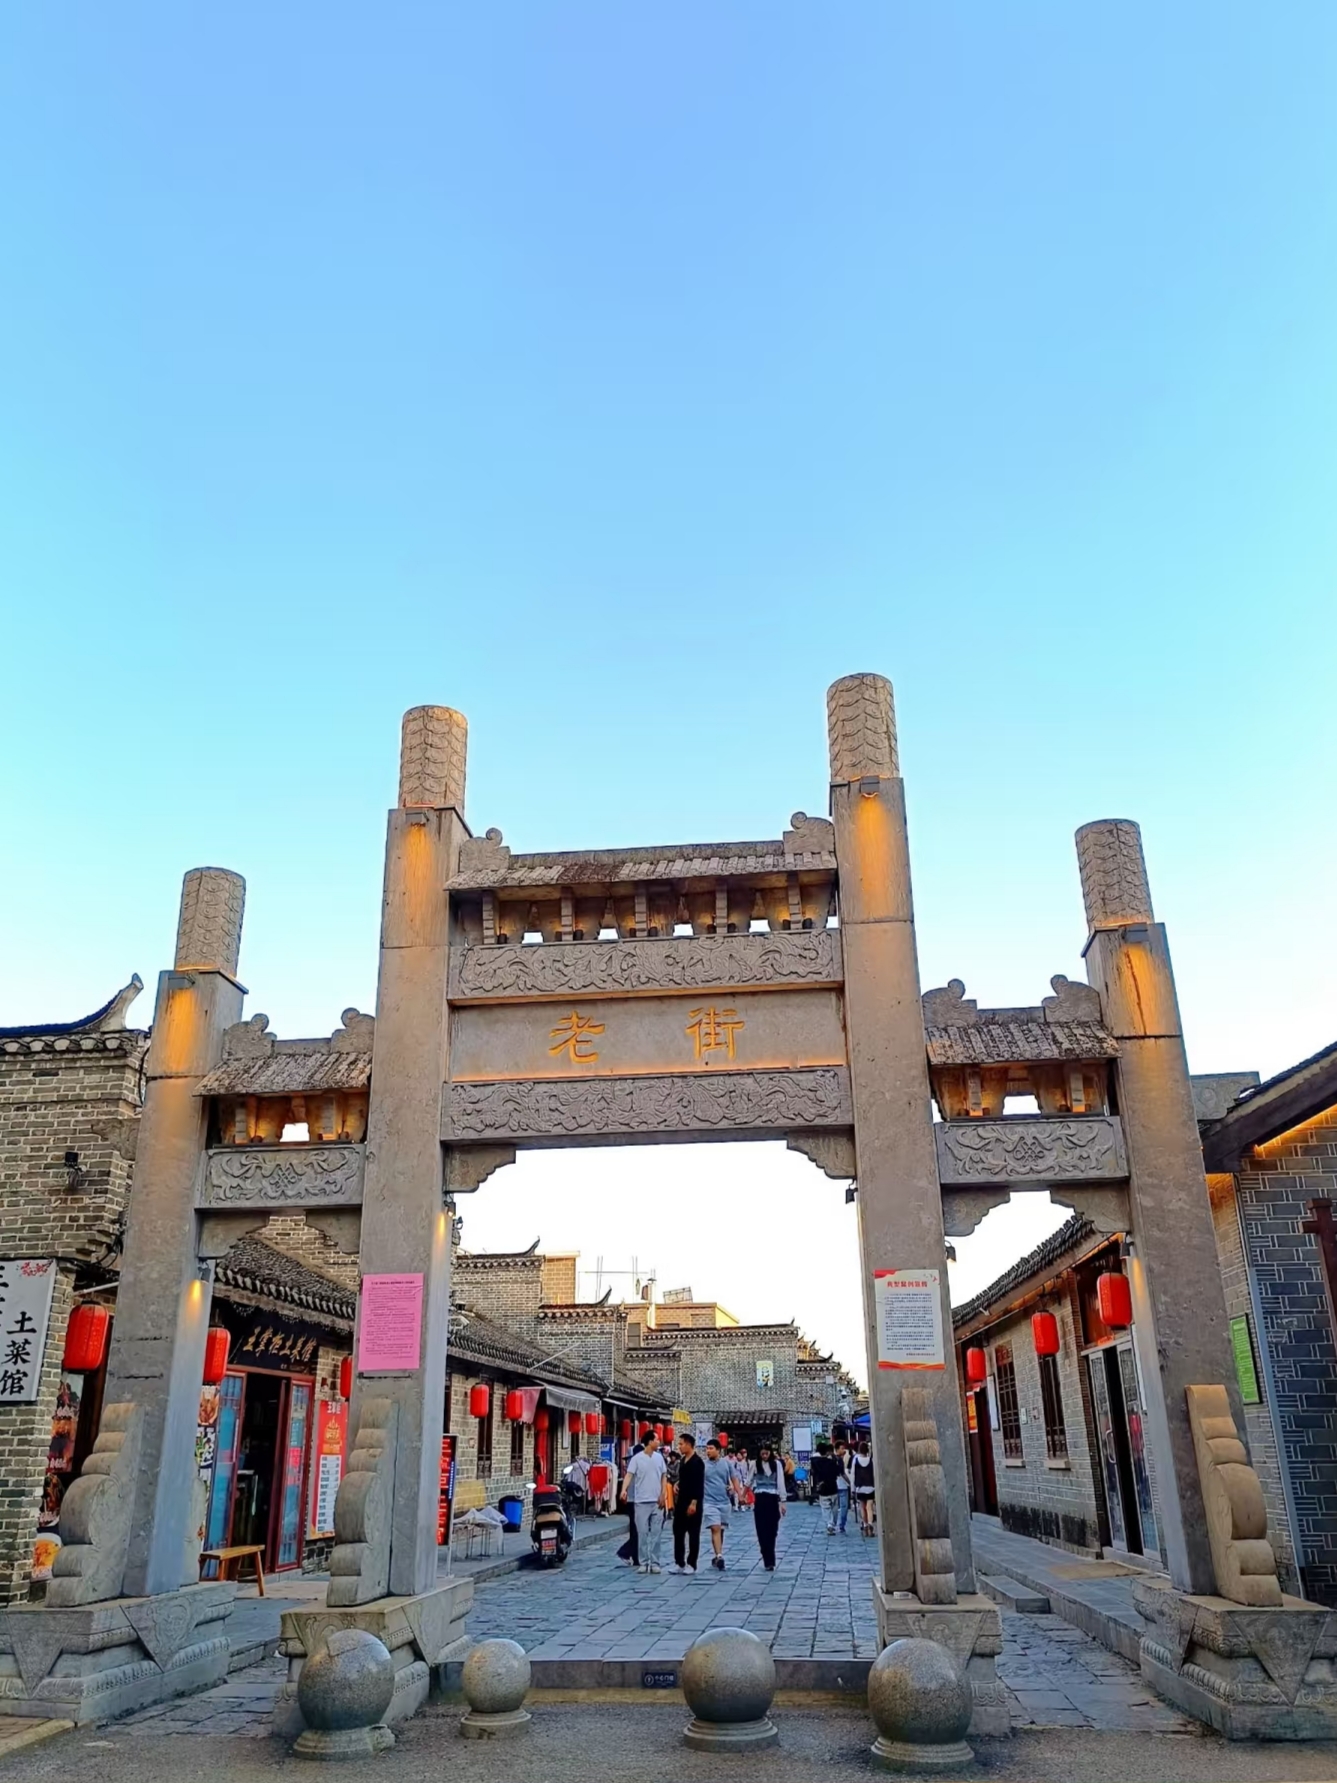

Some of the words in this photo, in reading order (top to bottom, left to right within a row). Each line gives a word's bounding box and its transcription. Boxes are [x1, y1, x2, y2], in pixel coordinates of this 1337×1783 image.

[548, 1006, 746, 1064] 老街
[0, 1311, 37, 1396] 土菜馆
